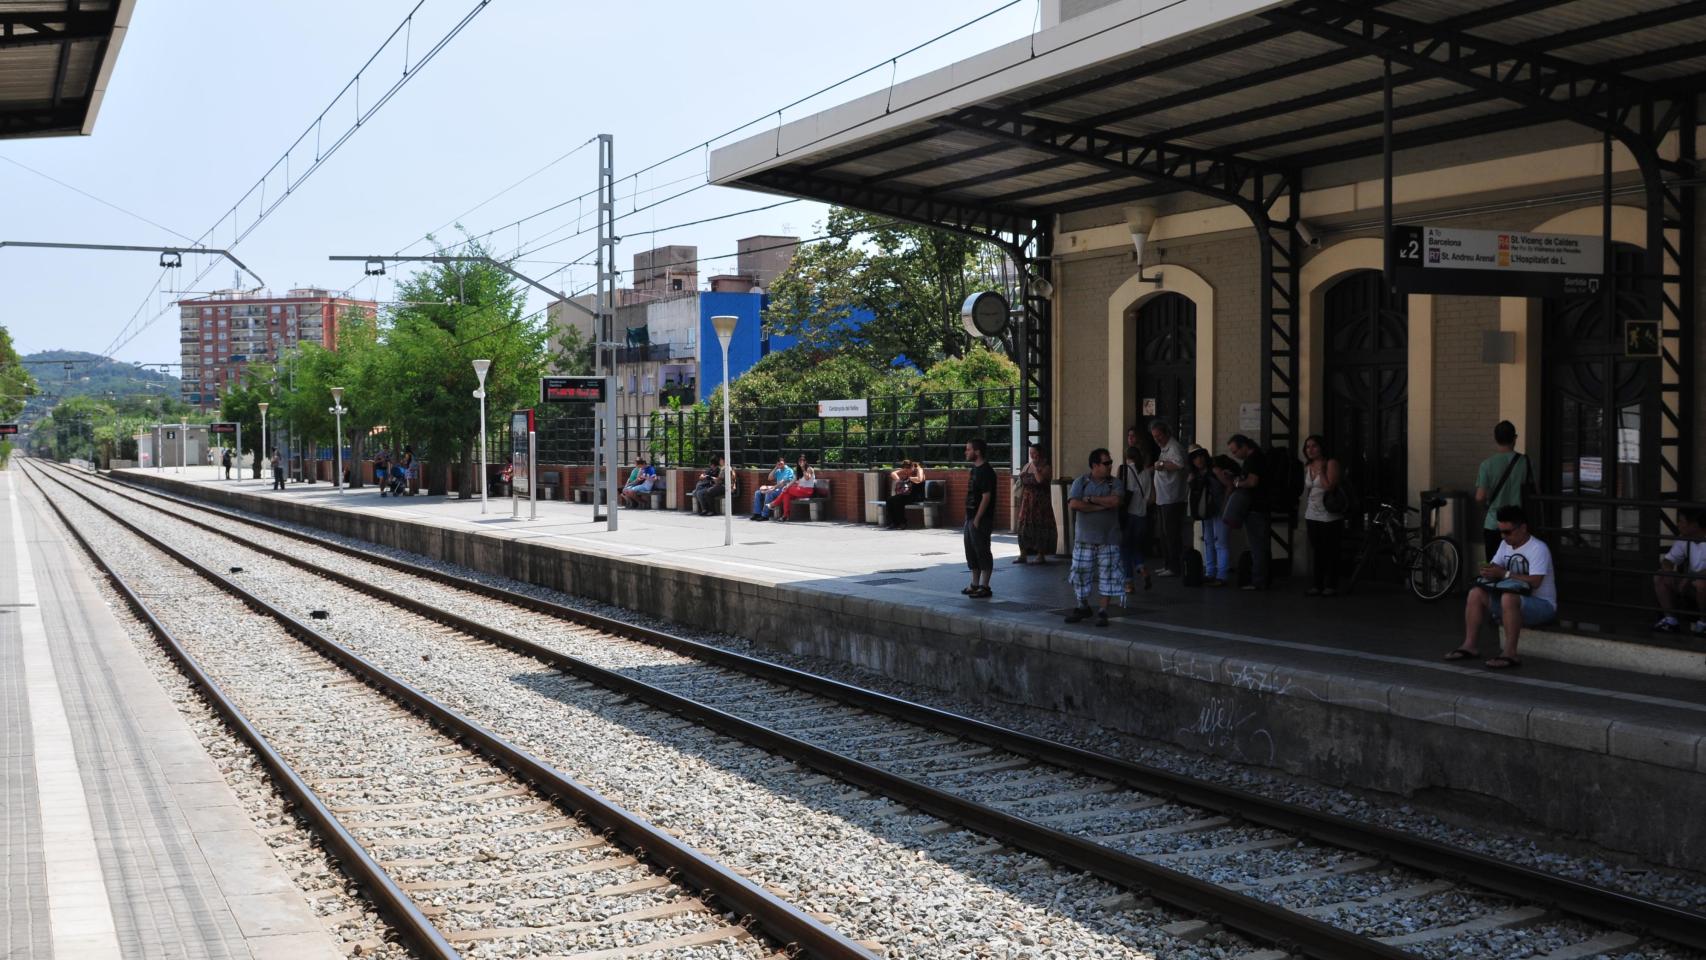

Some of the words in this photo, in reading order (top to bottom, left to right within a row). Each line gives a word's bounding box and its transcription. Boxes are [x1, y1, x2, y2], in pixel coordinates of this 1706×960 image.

[1429, 238, 1462, 246] Barcelona
[1511, 235, 1520, 244] St.
[1521, 236, 1543, 246] Vicenç
[1408, 240, 1419, 259] 2
[1442, 252, 1450, 260] St.
[1452, 253, 1474, 261] Andreu
[1511, 255, 1549, 265] L'Hospitalet
